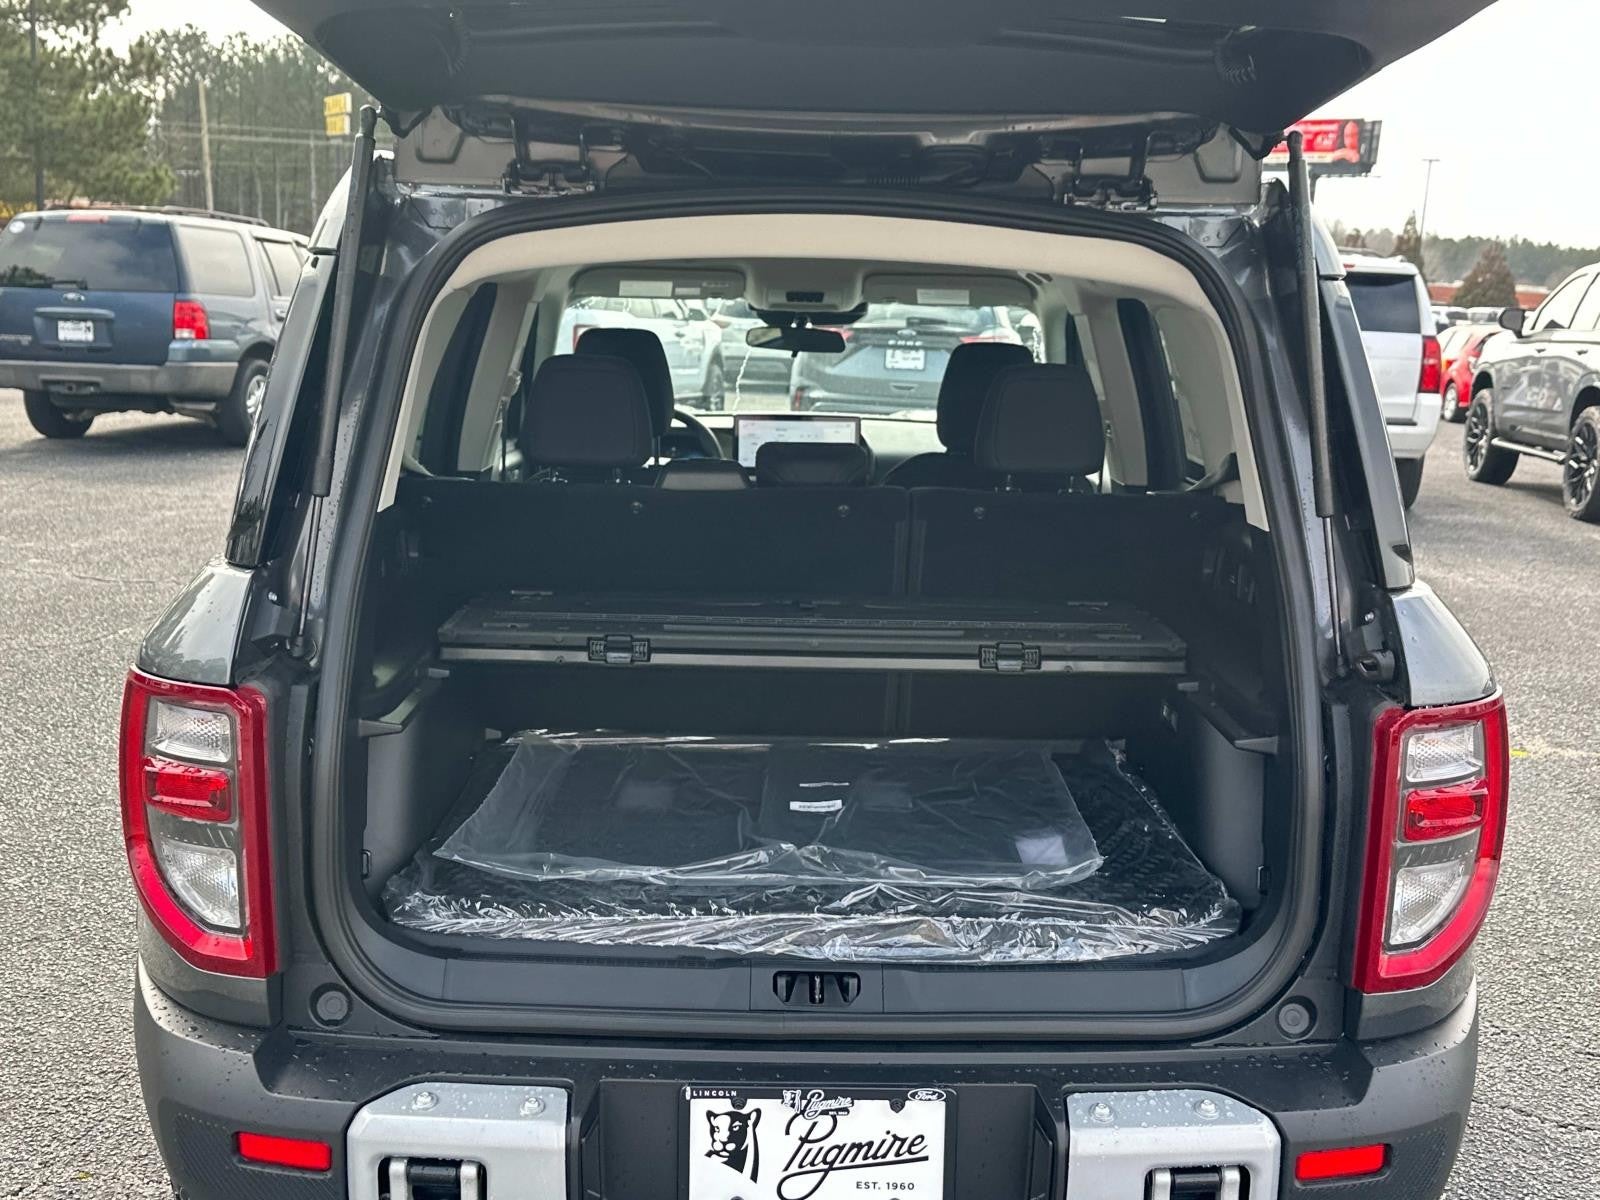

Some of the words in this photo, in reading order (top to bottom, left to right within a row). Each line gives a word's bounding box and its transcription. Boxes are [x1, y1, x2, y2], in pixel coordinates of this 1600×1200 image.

[804, 1089, 853, 1118] Pugmire
[914, 1090, 939, 1100] Ford
[776, 1112, 929, 1200] Pugmire
[855, 1181, 881, 1191] EST.
[886, 1182, 915, 1191] 1960
